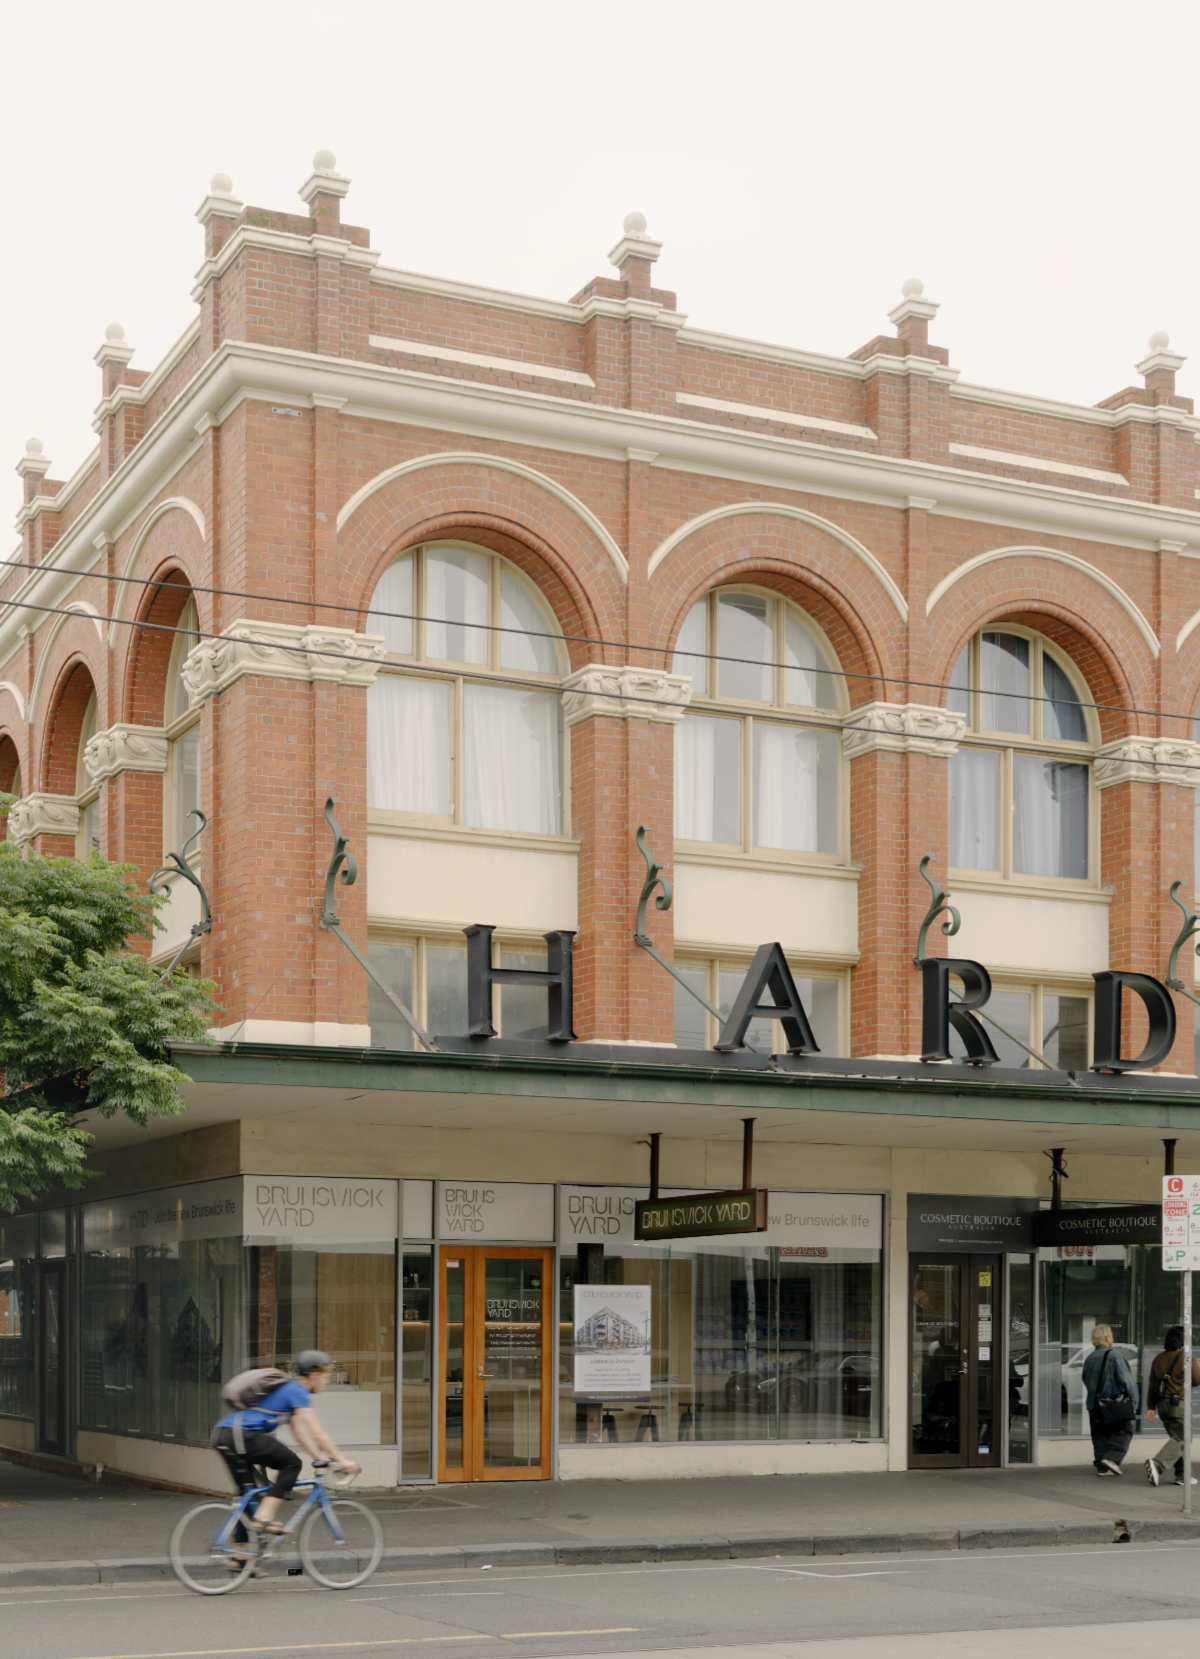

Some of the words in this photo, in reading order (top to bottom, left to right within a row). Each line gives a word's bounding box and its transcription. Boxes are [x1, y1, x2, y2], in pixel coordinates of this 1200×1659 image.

[462, 922, 1178, 1074] HARD
[255, 1185, 385, 1207] BRUNSWICK
[445, 1203, 483, 1217] WICK
[568, 1195, 637, 1215] BRUNS
[256, 1207, 315, 1227] YARD
[642, 1206, 712, 1229] BRUNSWICK
[716, 1202, 750, 1221] YARD
[784, 1213, 848, 1227] Brunswick
[850, 1214, 870, 1228] life
[920, 1213, 969, 1225] COSMETIC
[974, 1215, 1022, 1226] BOUTIQUE
[1059, 1218, 1106, 1231] COSMETIC
[1109, 1216, 1157, 1228] BOUTIQUE
[446, 1218, 485, 1233] YARD
[568, 1216, 621, 1235] YARD
[487, 1308, 512, 1318] YARD
